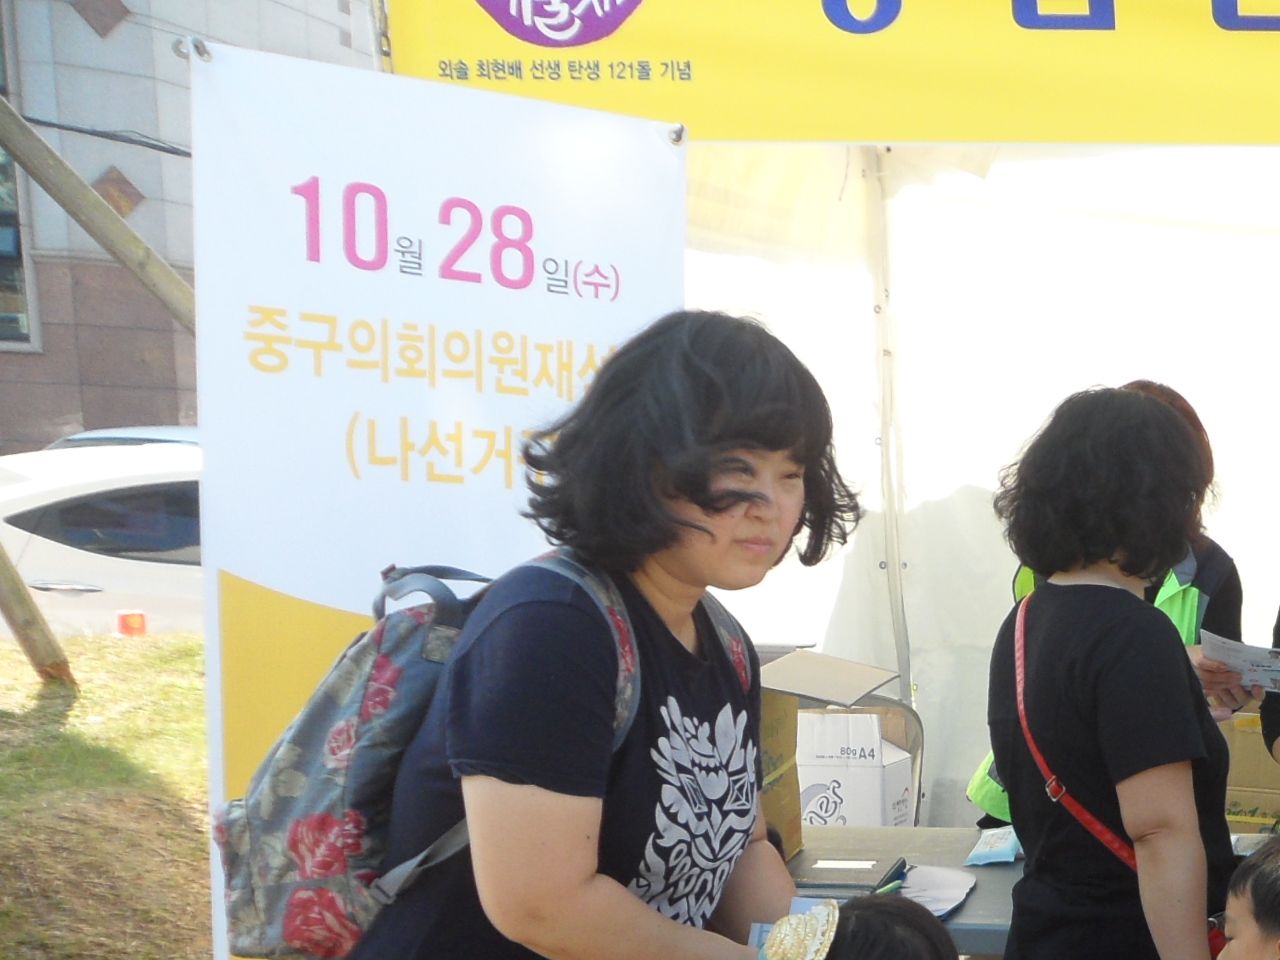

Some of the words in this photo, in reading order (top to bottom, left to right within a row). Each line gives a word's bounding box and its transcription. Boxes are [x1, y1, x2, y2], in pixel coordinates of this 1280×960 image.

[438, 59, 469, 80] 외솔
[476, 59, 523, 80] 최현배
[530, 60, 561, 80] 선생
[568, 60, 600, 80] 탄생
[608, 61, 652, 80] 121돌
[660, 60, 692, 81] 기념
[290, 176, 423, 276] 10월
[840, 747, 857, 756] 80g
[859, 747, 875, 760] A4
